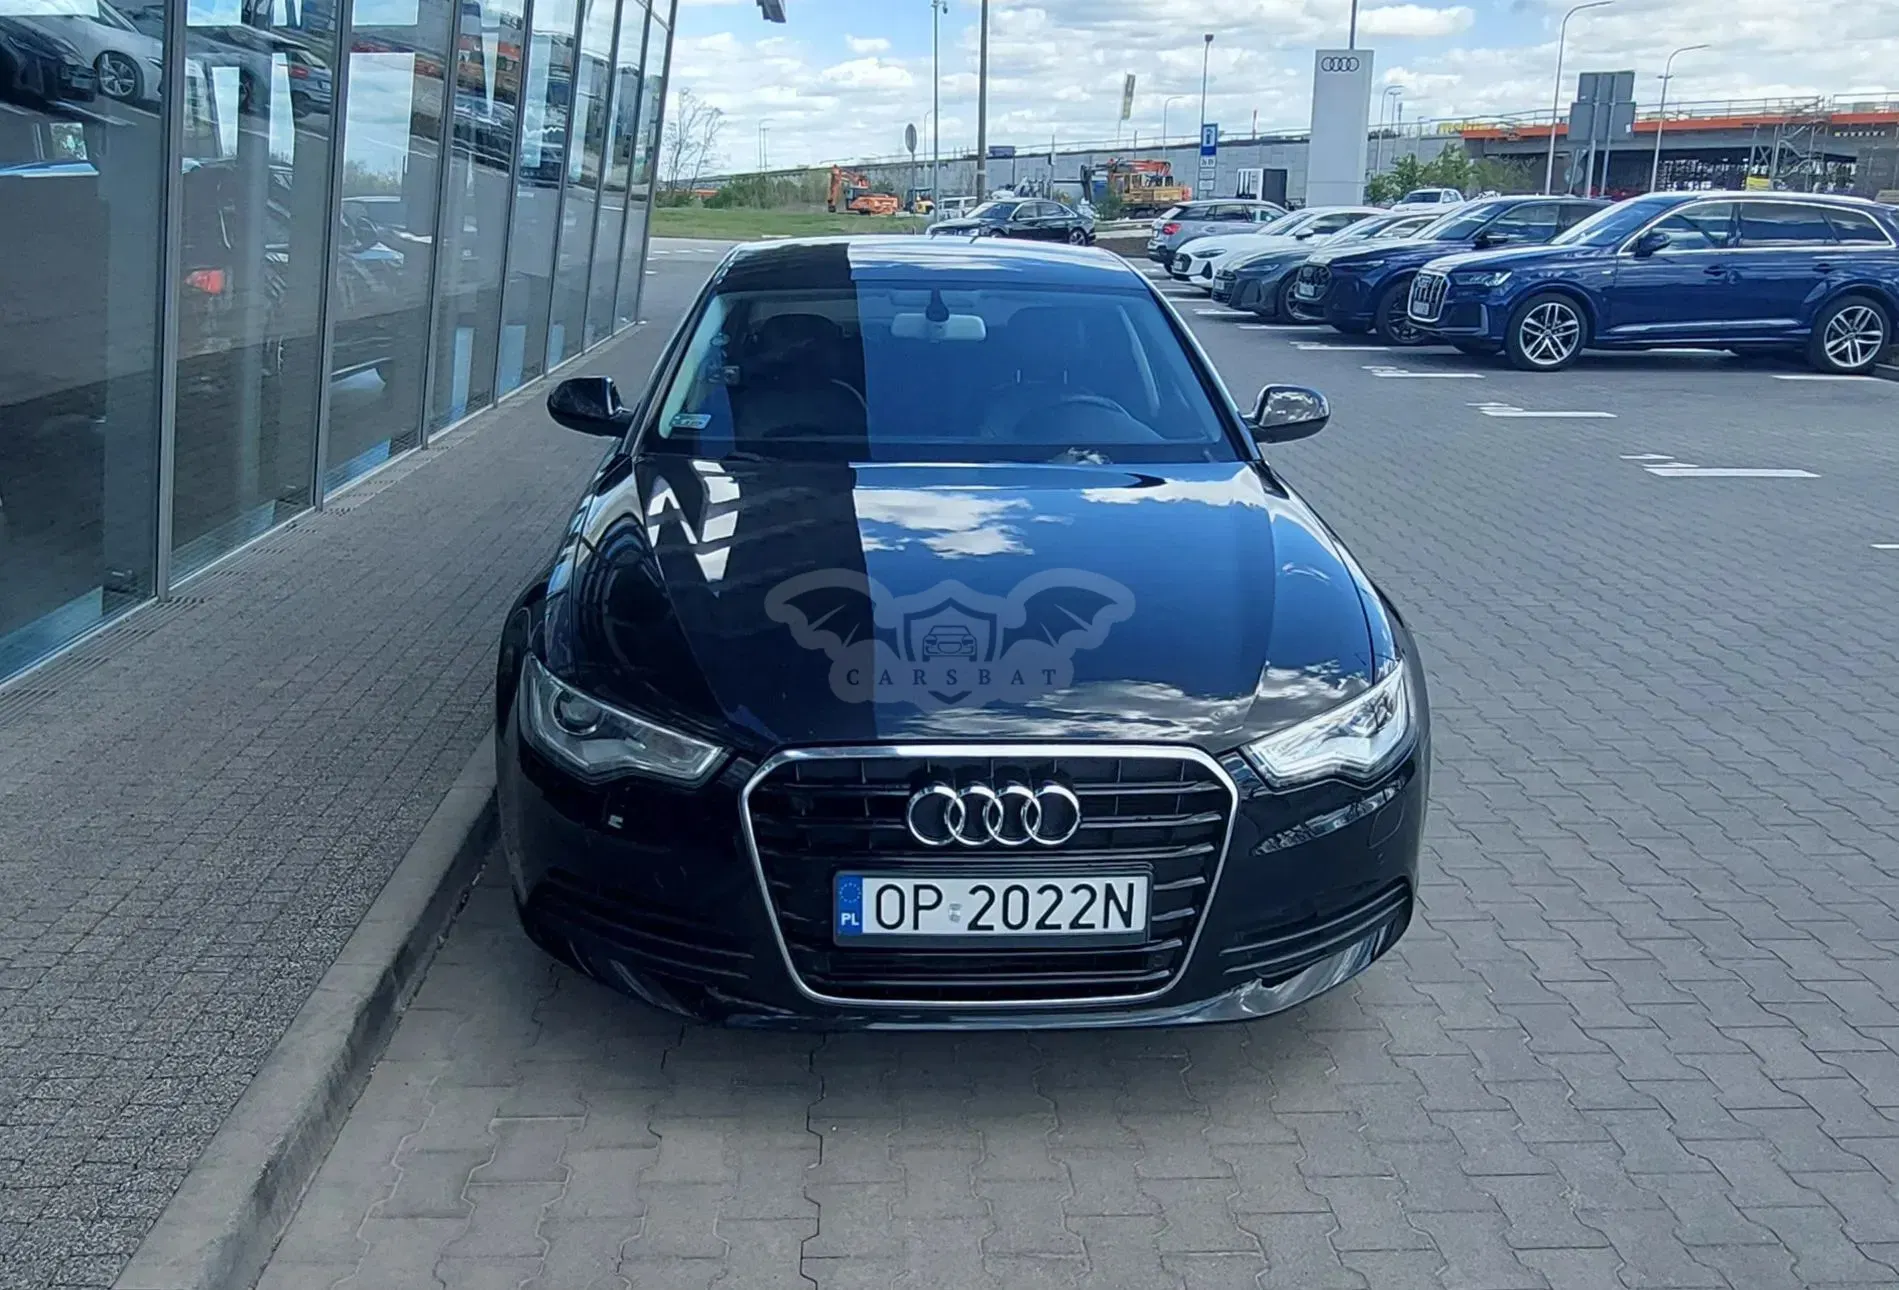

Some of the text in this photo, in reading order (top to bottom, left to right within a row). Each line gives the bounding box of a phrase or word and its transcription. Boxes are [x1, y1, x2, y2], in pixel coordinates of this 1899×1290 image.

[841, 912, 860, 926] PL
[875, 882, 1135, 931] OP 2022N
